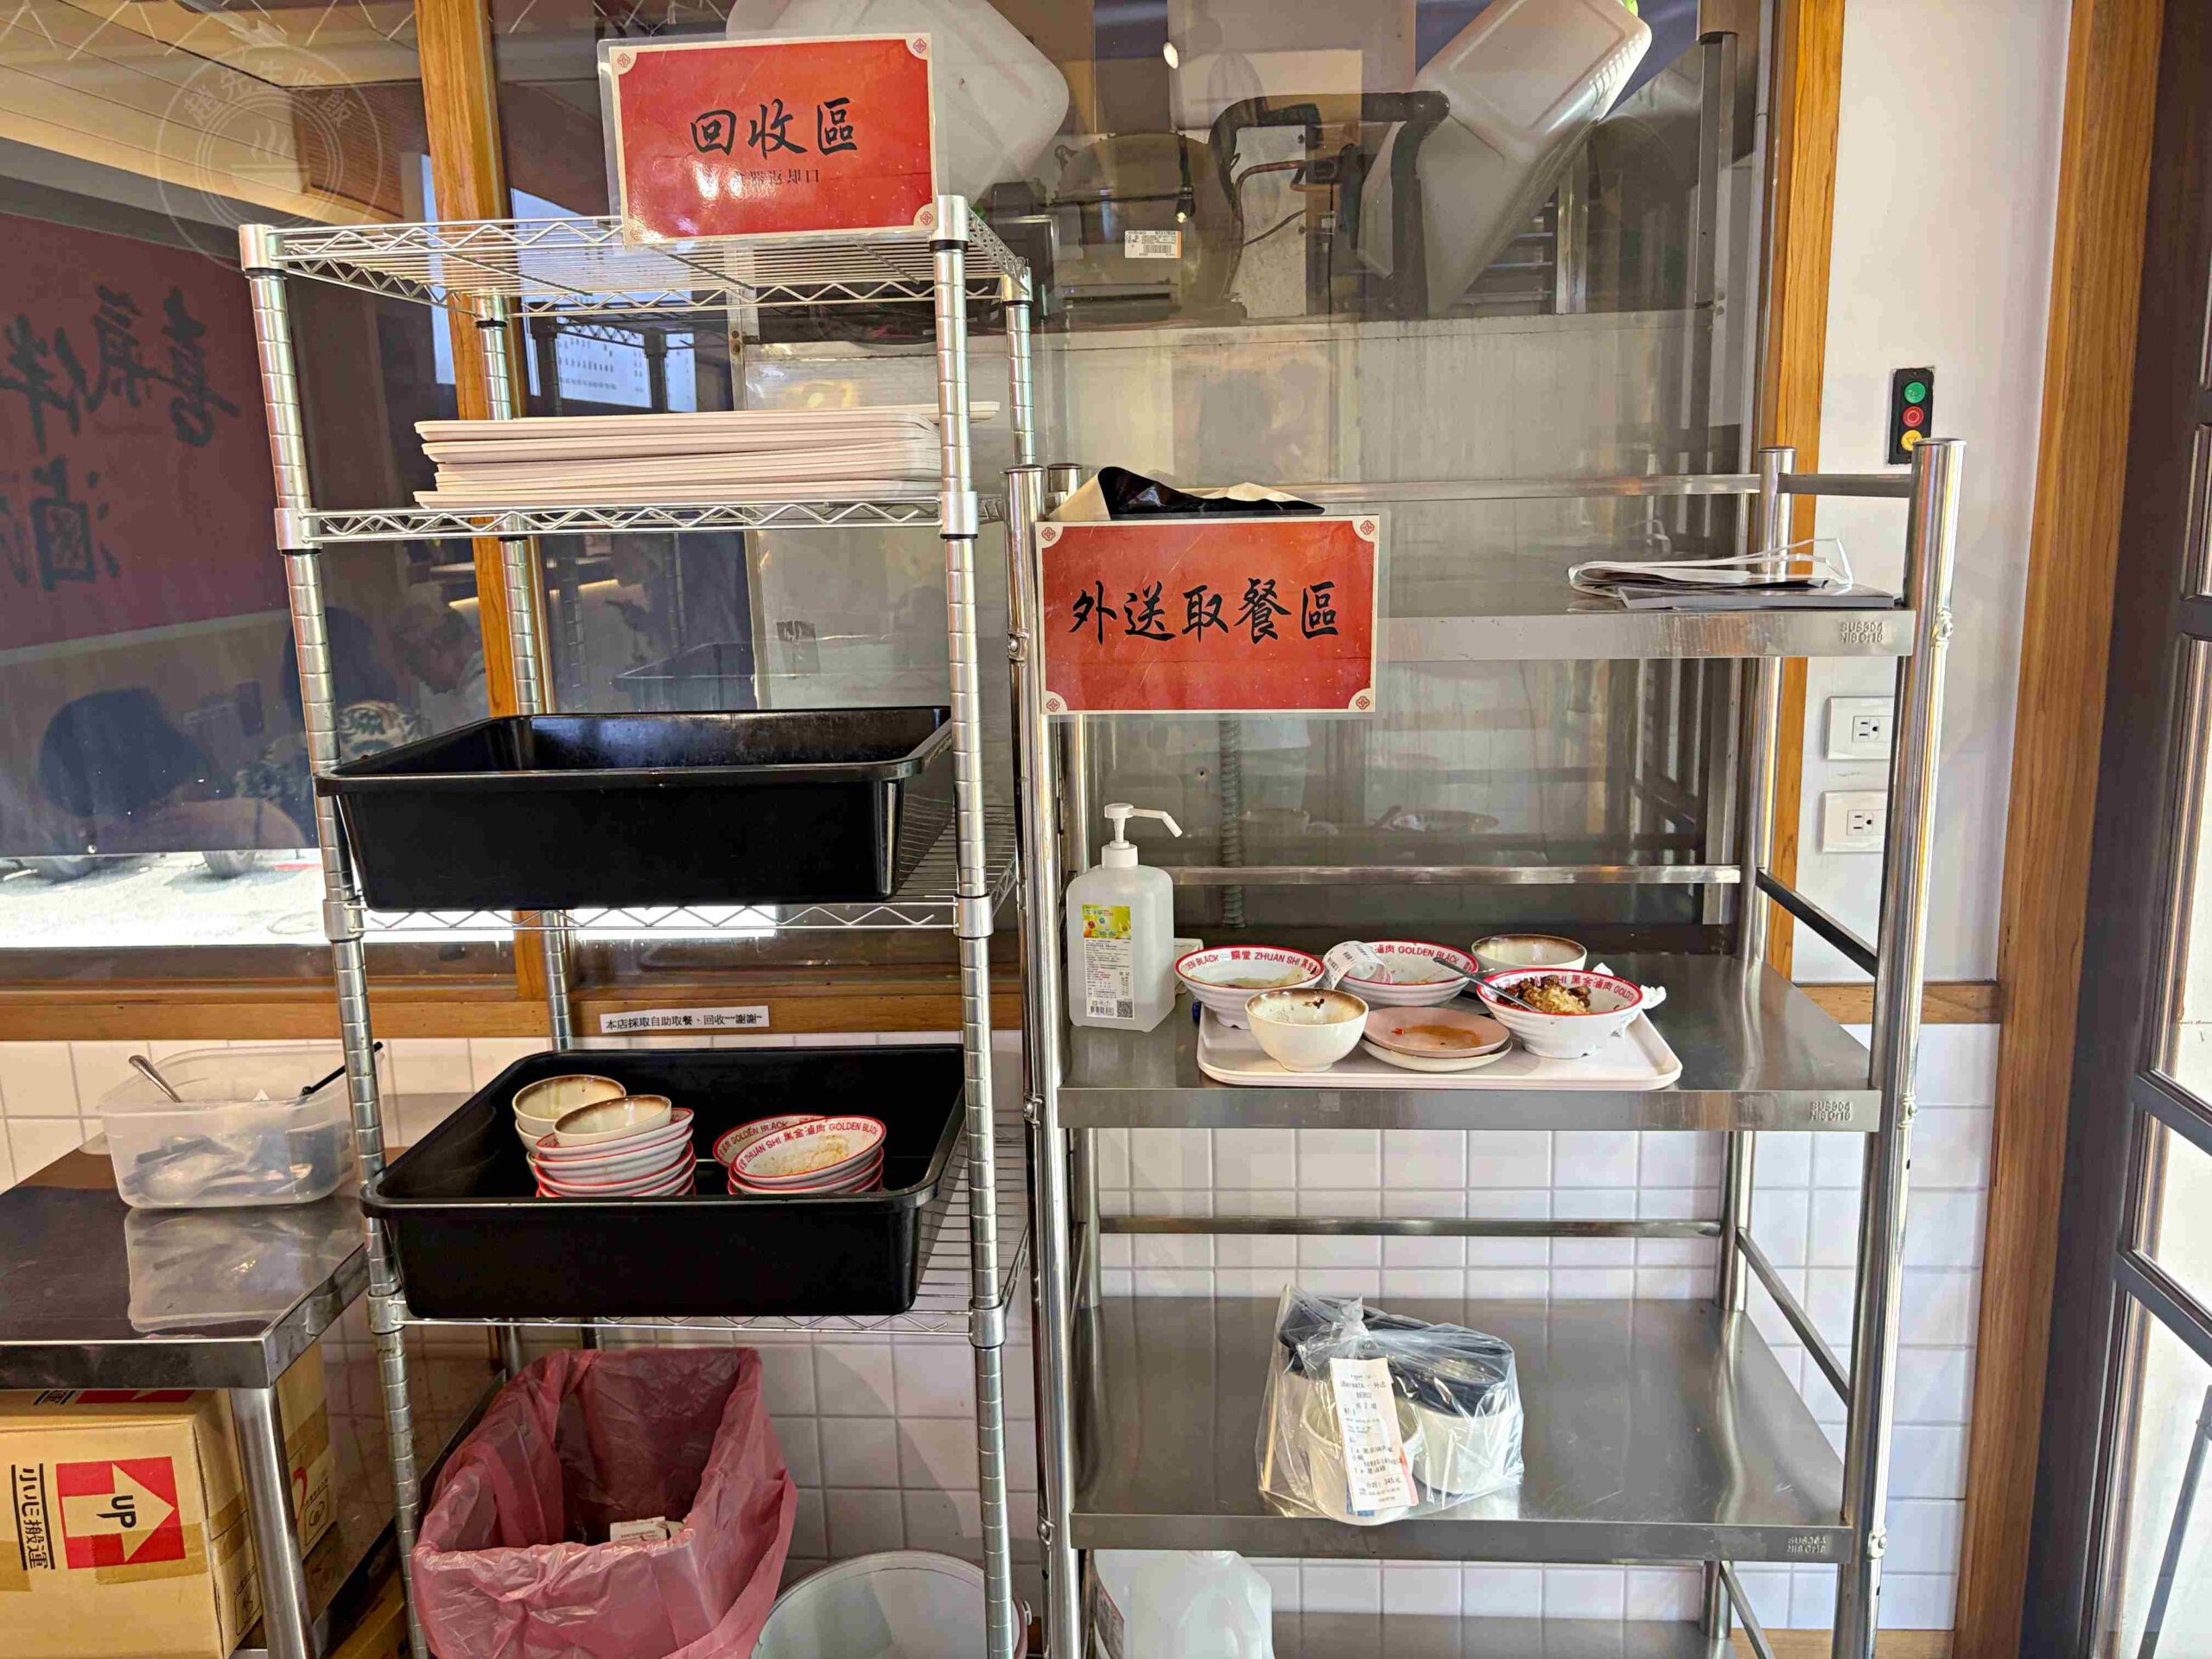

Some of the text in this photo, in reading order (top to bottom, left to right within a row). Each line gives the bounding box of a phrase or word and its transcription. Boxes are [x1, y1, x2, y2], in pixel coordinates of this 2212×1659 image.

[690, 97, 858, 160] 回收區
[1068, 577, 1339, 645] 外送取餐區
[1195, 954, 1220, 965] BLACK
[1254, 951, 1286, 963] ZHUAN
[1287, 956, 1300, 965] SHI
[1397, 945, 1435, 957] GOLDEN
[731, 1127, 759, 1144] GOLDEN
[760, 1121, 788, 1132] BLACK
[744, 1144, 766, 1162] ZHUAN
[766, 1136, 782, 1148] SHI
[783, 1124, 826, 1142] 黑金滷肉
[829, 1122, 861, 1131] GOLDEN
[18, 1467, 49, 1570] 小心搬運
[96, 1494, 137, 1529] UP
